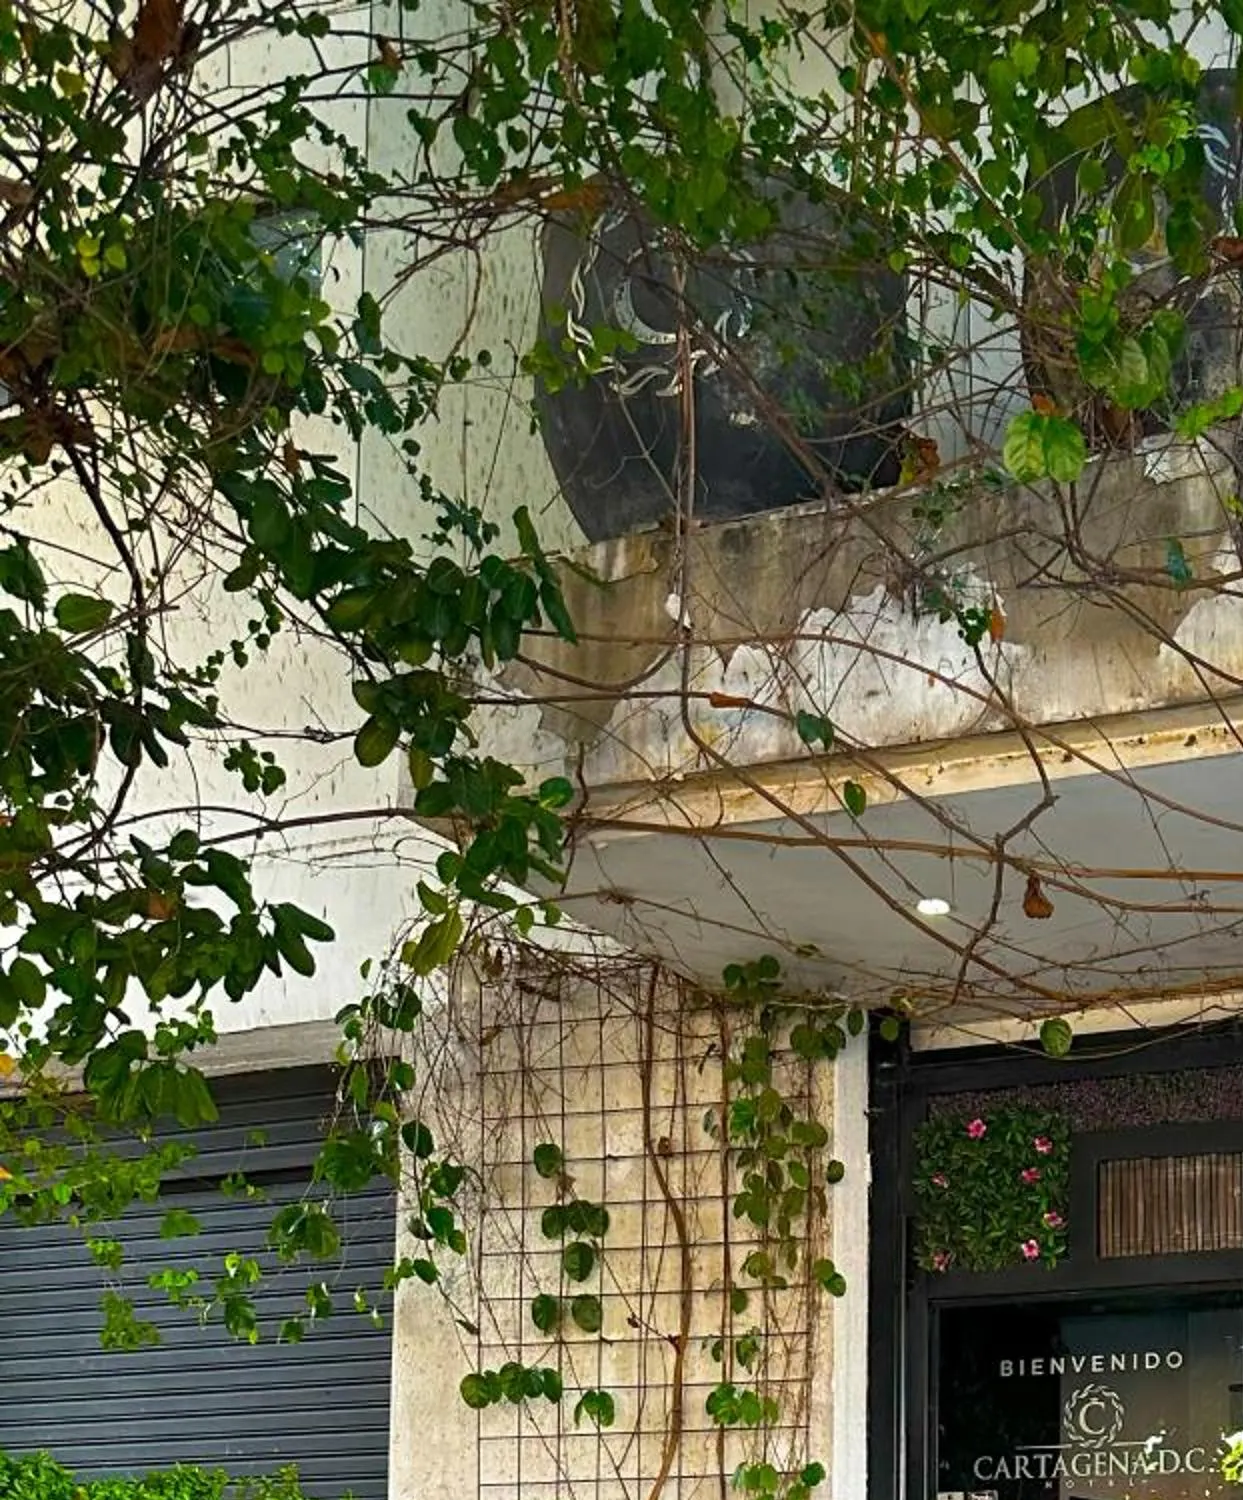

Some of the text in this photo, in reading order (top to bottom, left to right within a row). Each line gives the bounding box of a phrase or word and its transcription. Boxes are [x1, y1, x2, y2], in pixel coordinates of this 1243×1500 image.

[1000, 1350, 1184, 1377] BIENVENIDO
[1079, 1401, 1105, 1435] C
[973, 1447, 1215, 1481] CARTAGENA D.C.
